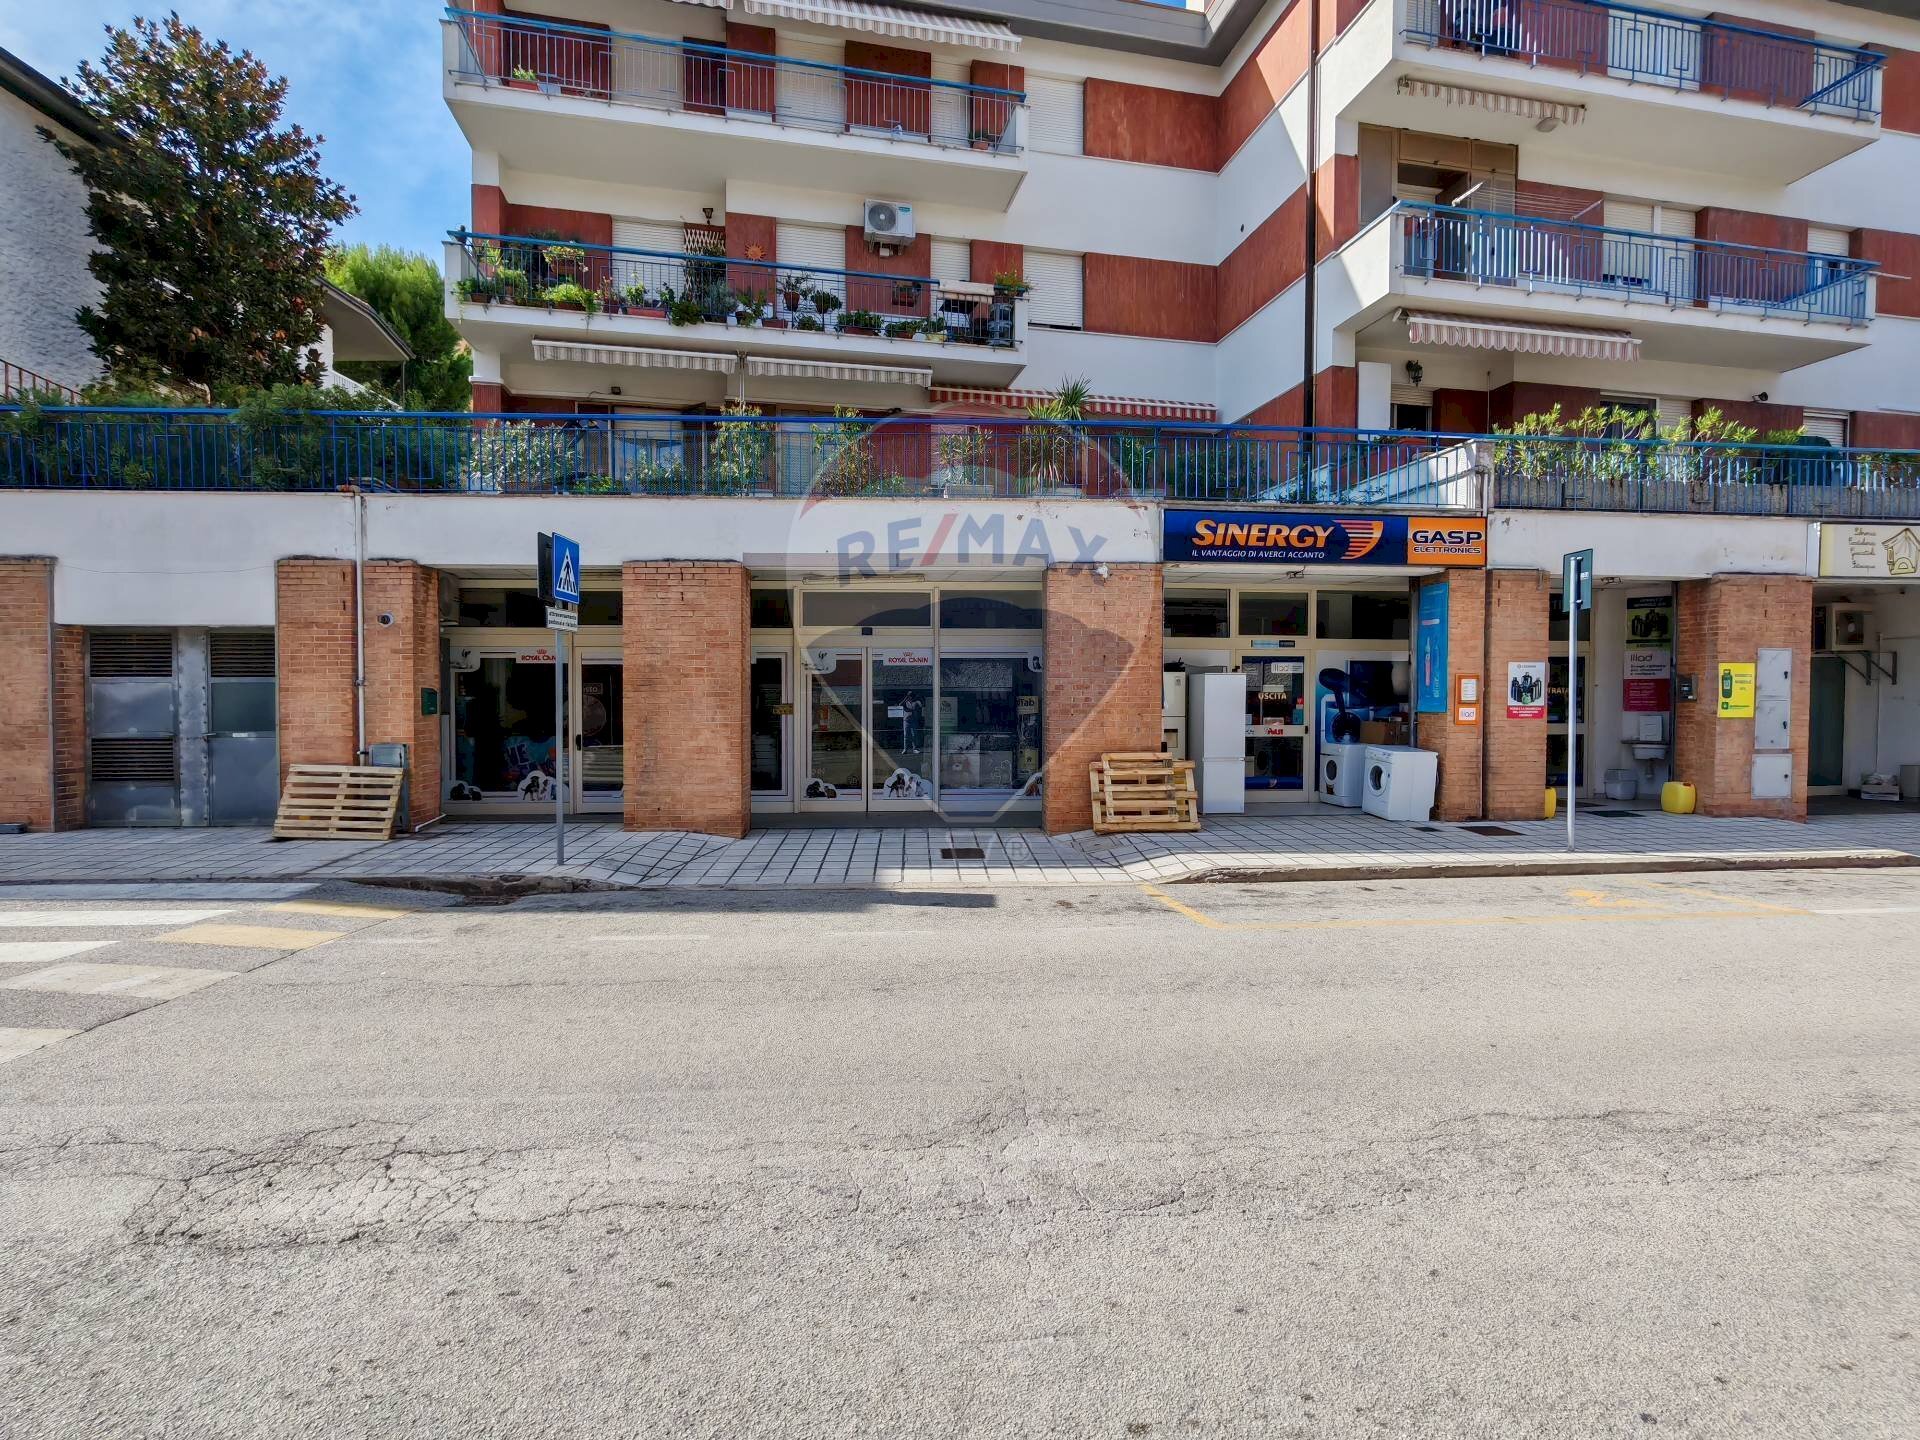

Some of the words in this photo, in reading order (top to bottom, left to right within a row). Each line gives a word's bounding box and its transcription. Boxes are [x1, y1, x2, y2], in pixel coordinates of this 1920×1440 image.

[1191, 519, 1336, 548] SINERGY
[1411, 529, 1483, 545] GASP
[1412, 546, 1481, 554] ELETTRONICS
[1201, 550, 1247, 558] VANTAGGIO
[1248, 550, 1257, 558] DI
[1287, 551, 1325, 559] ACCANTO
[888, 656, 907, 664] ROYAL
[908, 656, 929, 664] CANIN
[1258, 692, 1287, 700] USCITA
